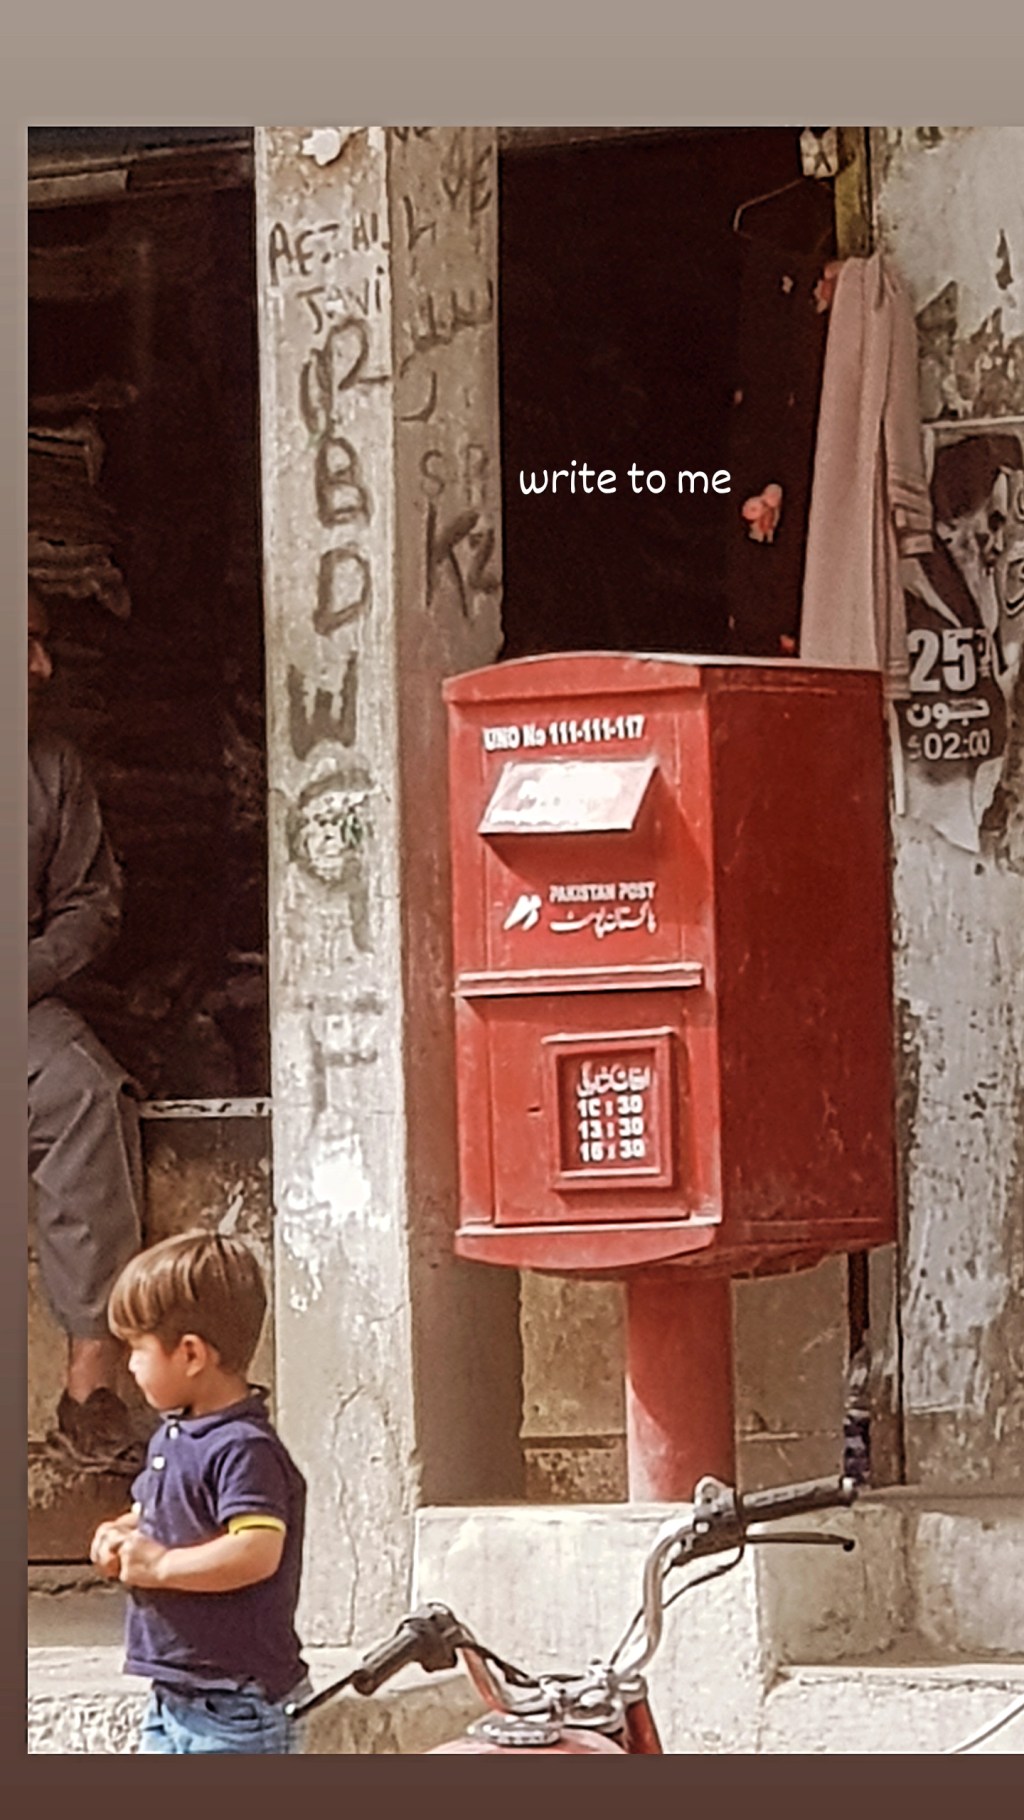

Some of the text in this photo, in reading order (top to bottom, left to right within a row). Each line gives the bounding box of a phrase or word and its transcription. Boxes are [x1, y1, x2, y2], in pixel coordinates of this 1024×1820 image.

[907, 627, 977, 692] 25
[549, 881, 657, 903] PAKISTAN POST
